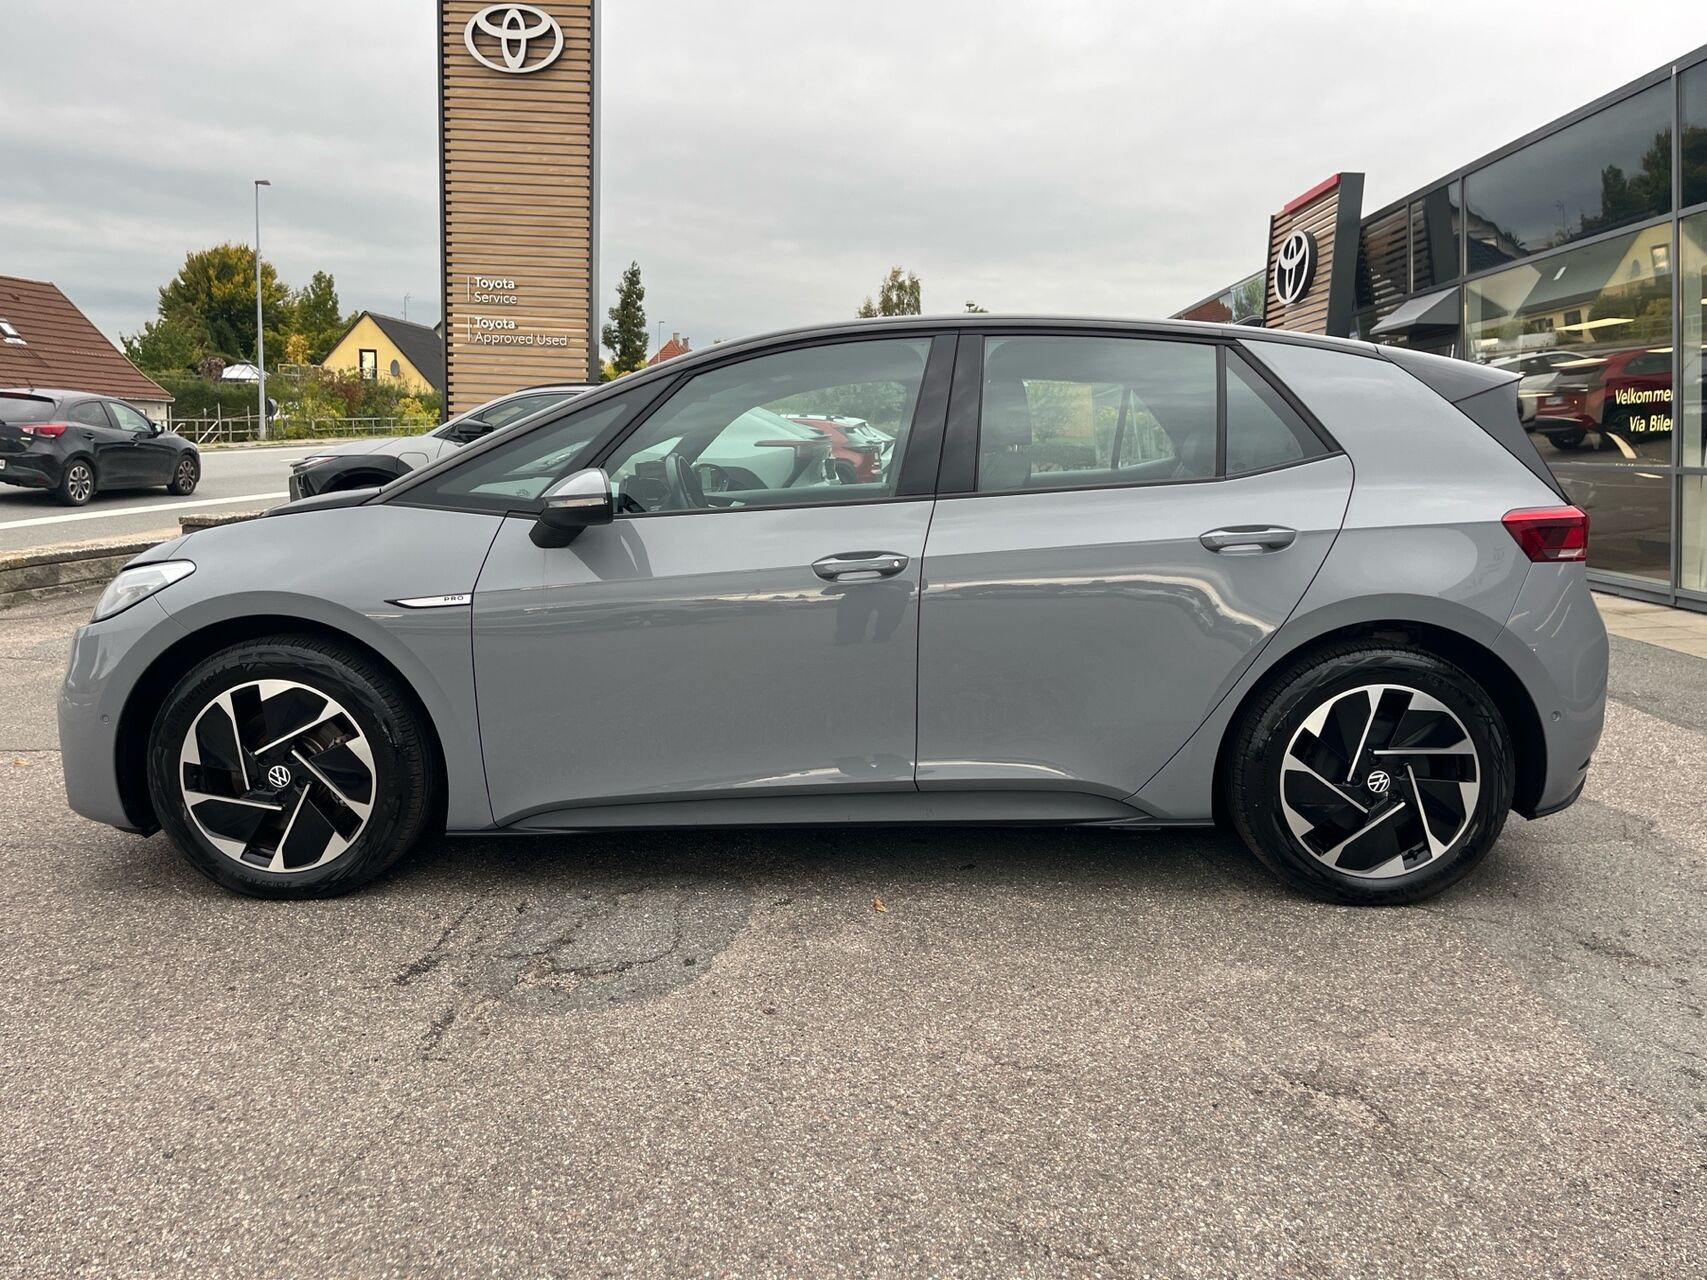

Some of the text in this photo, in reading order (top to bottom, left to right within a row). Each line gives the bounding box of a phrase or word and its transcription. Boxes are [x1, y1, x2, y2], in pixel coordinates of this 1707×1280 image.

[474, 276, 515, 291] Toyota
[474, 292, 517, 304] Service
[474, 316, 515, 331] Toyota
[474, 332, 567, 346] Approved Used
[1629, 415, 1646, 432] Via
